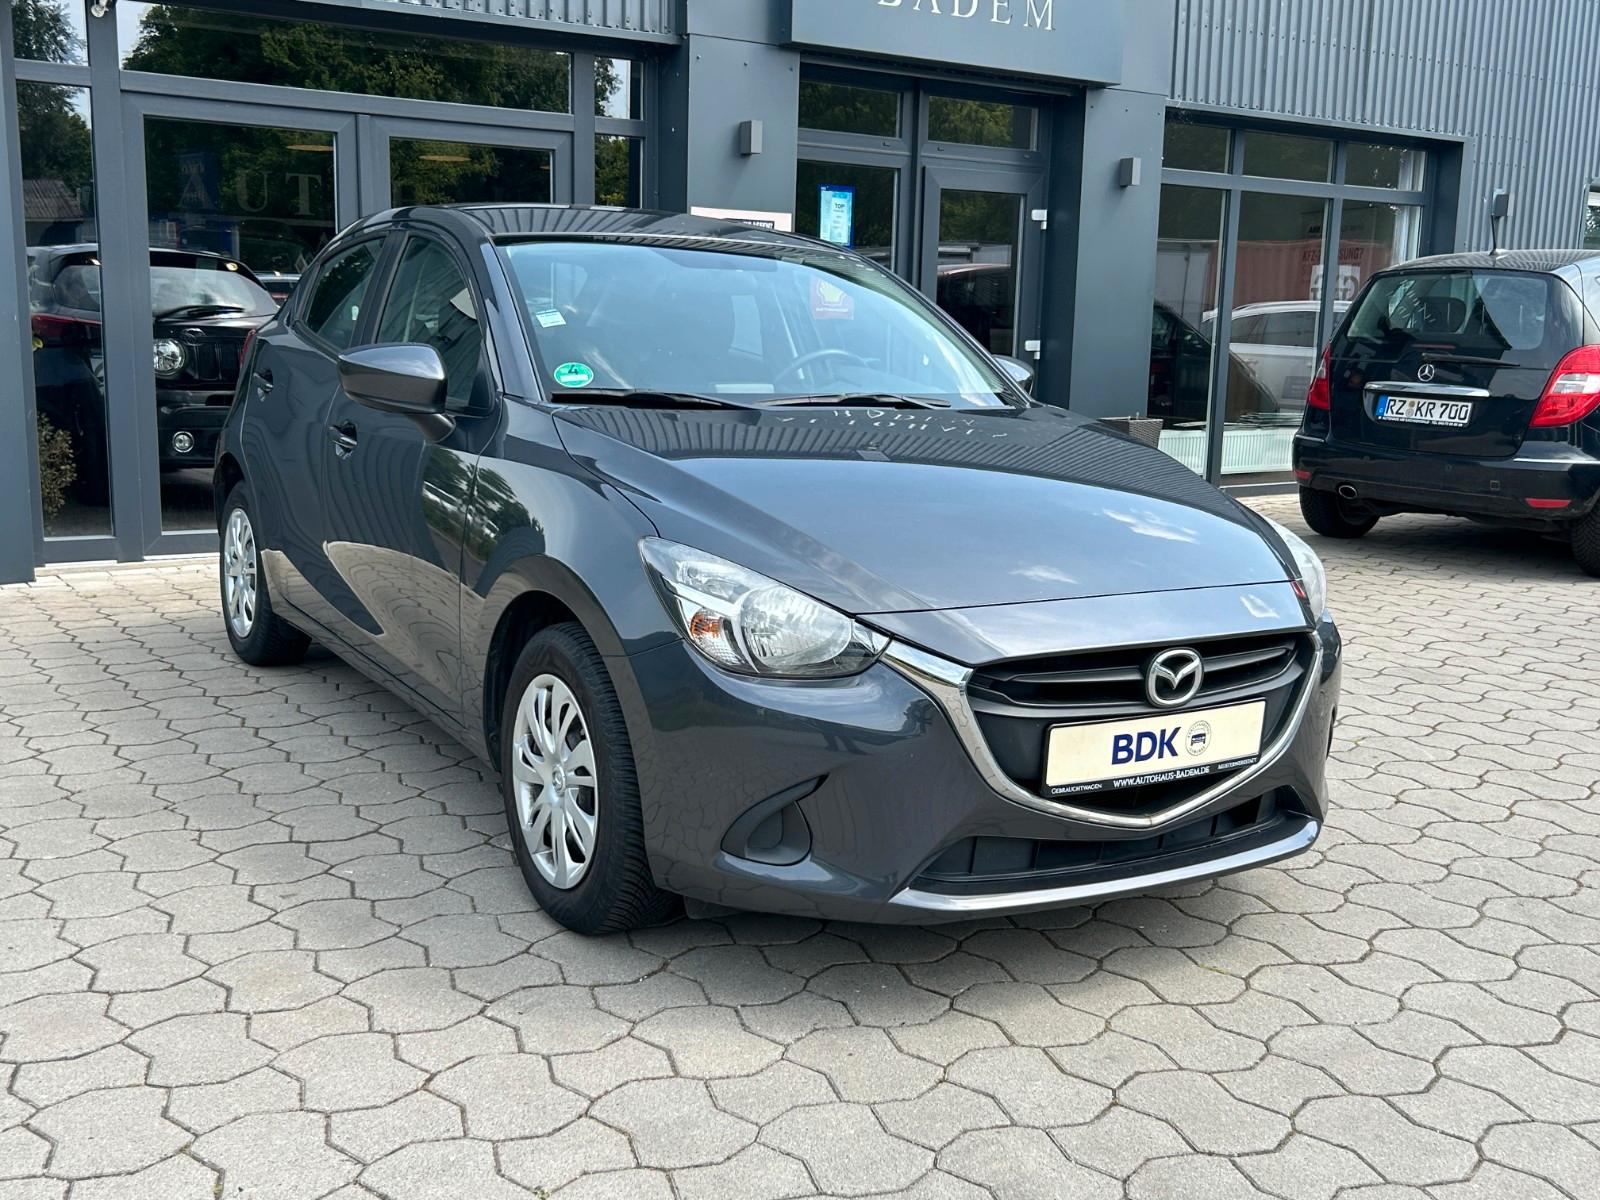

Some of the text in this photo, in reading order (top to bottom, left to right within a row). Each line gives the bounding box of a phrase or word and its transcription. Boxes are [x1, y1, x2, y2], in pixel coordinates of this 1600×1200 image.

[567, 364, 579, 375] 4
[1386, 399, 1407, 416] RZ
[1414, 401, 1436, 418] KR
[1439, 403, 1469, 421] 700
[1111, 726, 1182, 766] BDK
